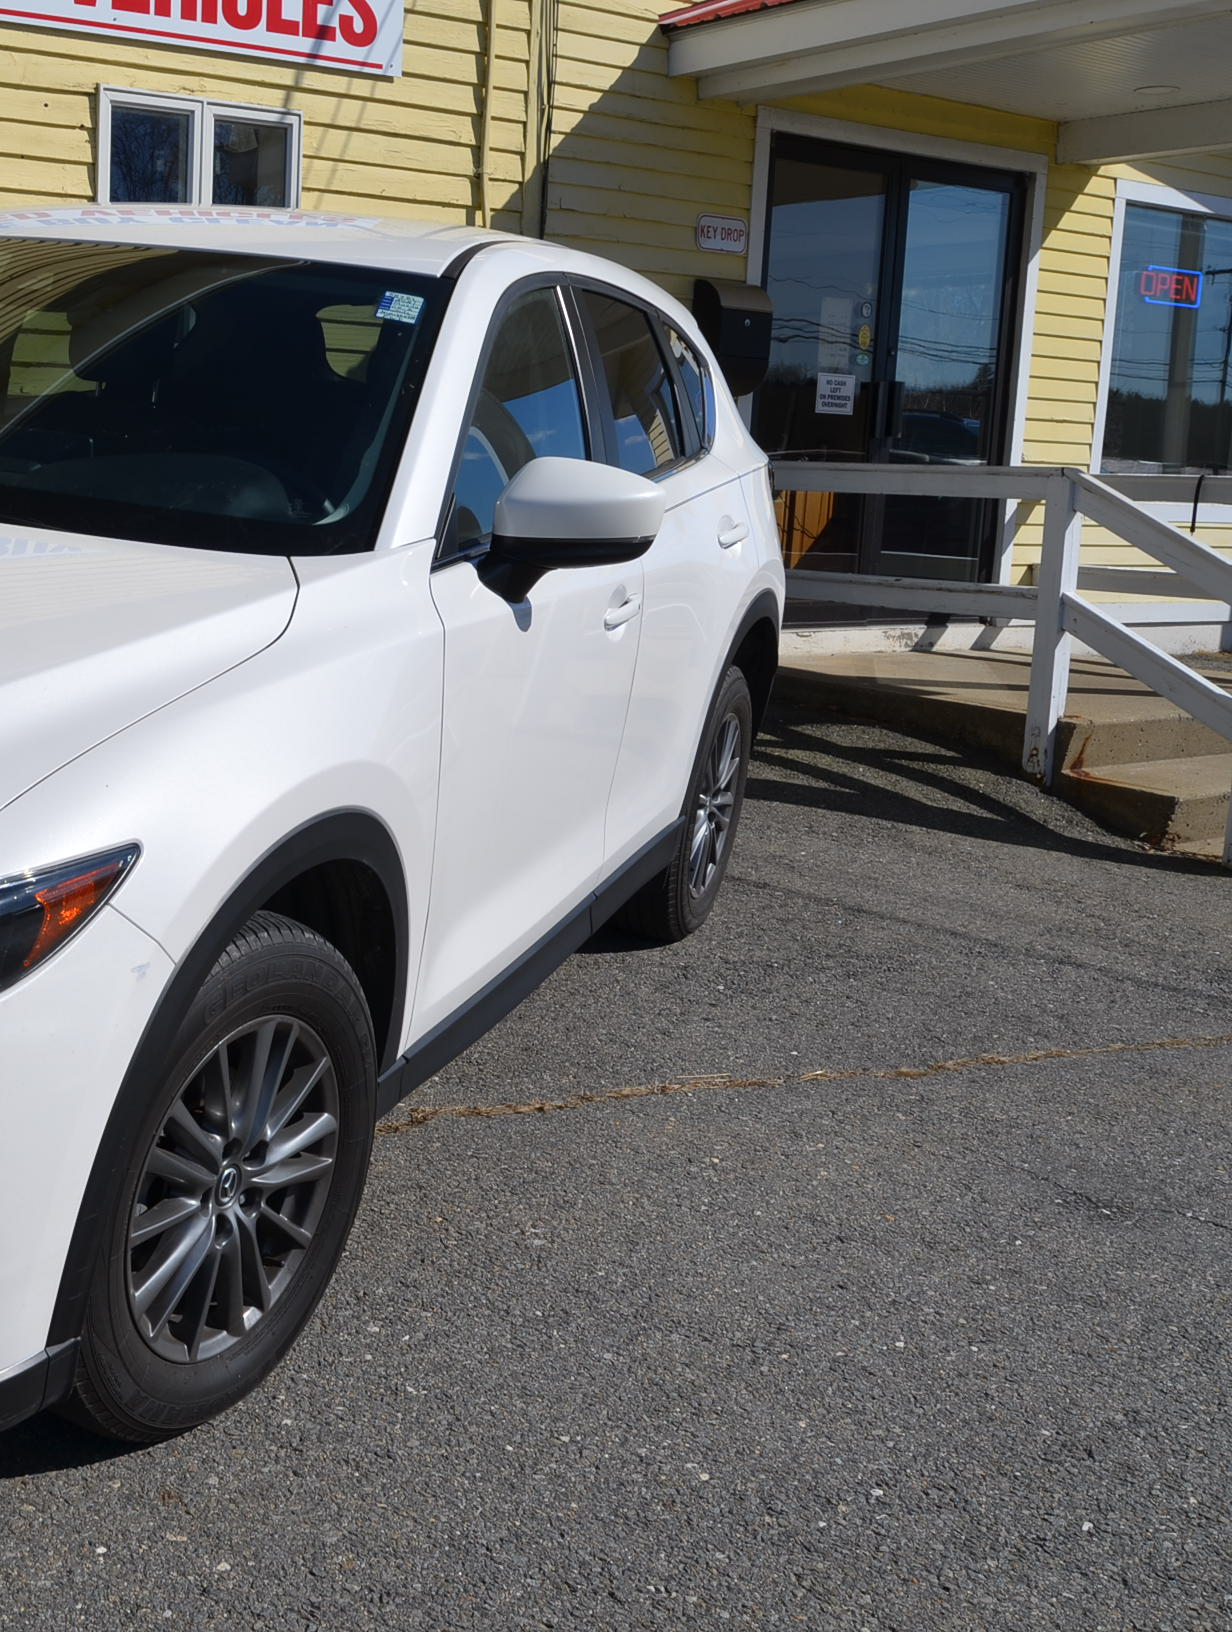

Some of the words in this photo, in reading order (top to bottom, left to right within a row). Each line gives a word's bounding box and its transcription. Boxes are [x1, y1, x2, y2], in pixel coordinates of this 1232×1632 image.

[700, 224, 718, 240] KEY
[720, 226, 745, 242] DROP
[1139, 271, 1198, 302] OPEN
[821, 401, 848, 409] OVERNIGHT
